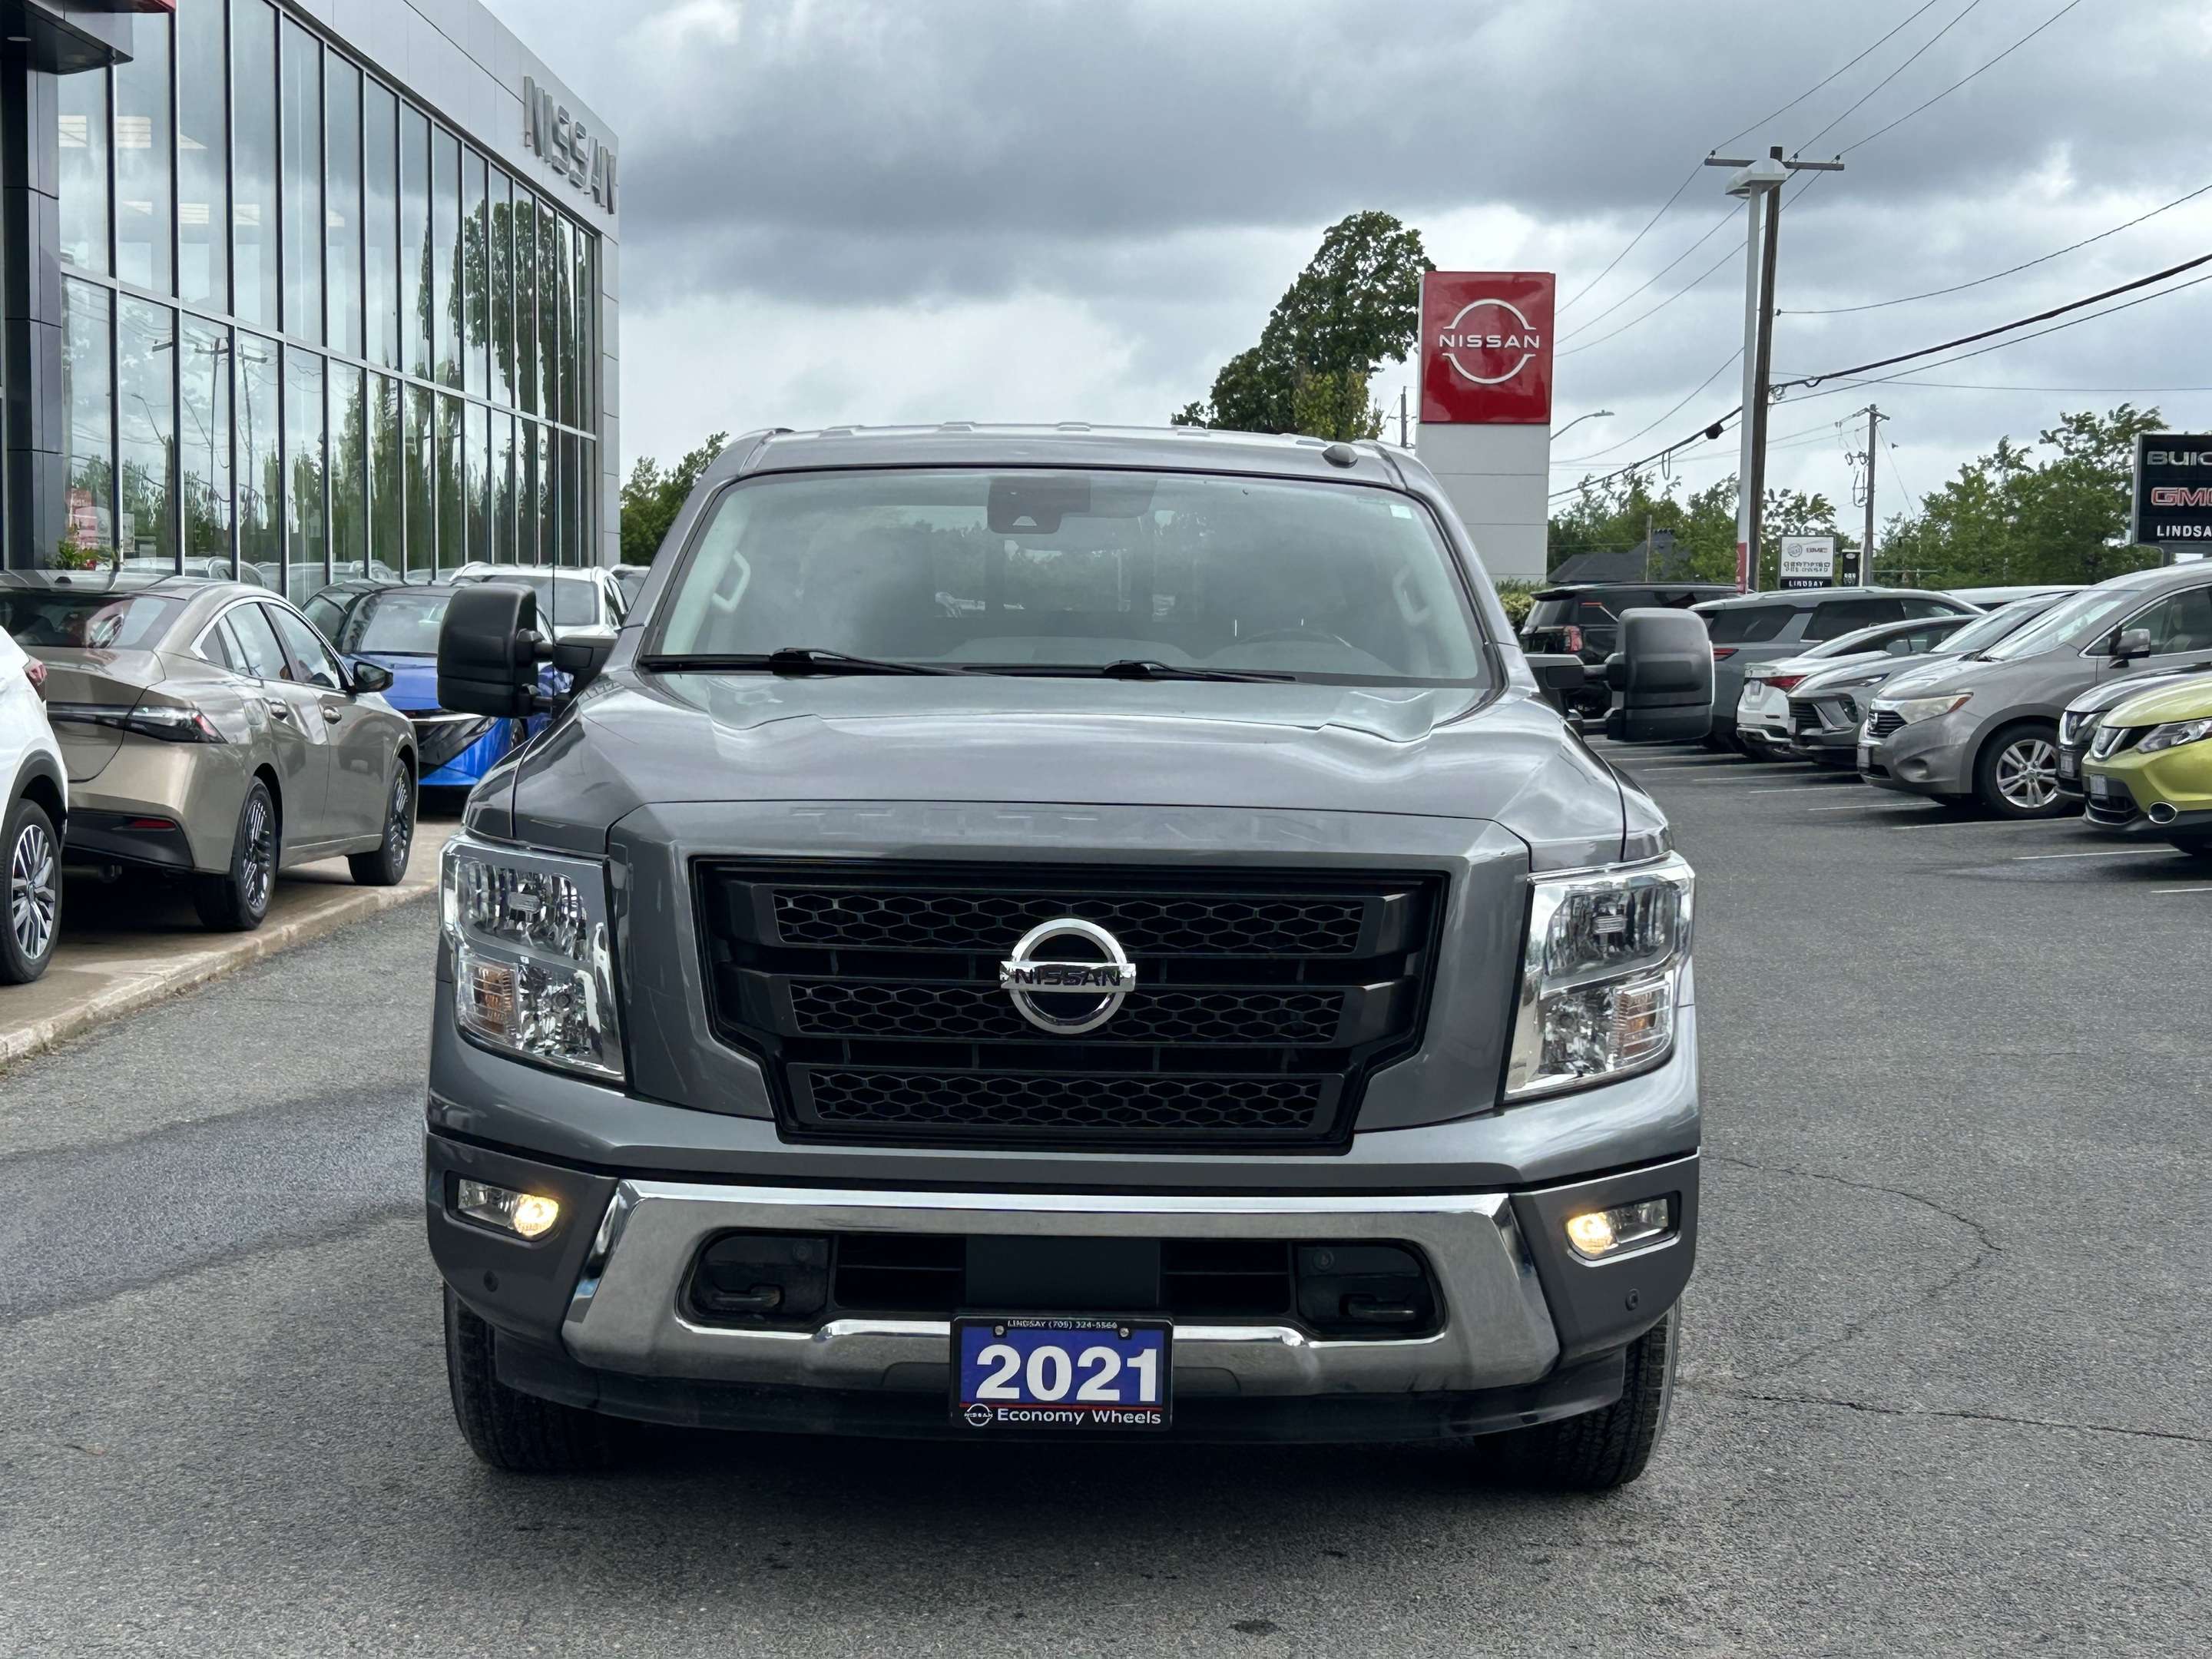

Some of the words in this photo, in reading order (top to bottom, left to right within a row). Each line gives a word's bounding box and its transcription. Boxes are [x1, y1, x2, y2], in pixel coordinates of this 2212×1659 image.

[524, 76, 617, 215] NISSAN
[1439, 333, 1541, 349] NISSAN
[2151, 486, 2212, 507] GM
[1014, 967, 1121, 987] NISSAN
[1007, 1320, 1046, 1328] LINDSAY
[976, 1343, 1157, 1402] 2021
[998, 1408, 1084, 1426] Economy
[1092, 1409, 1162, 1425] Wheels
